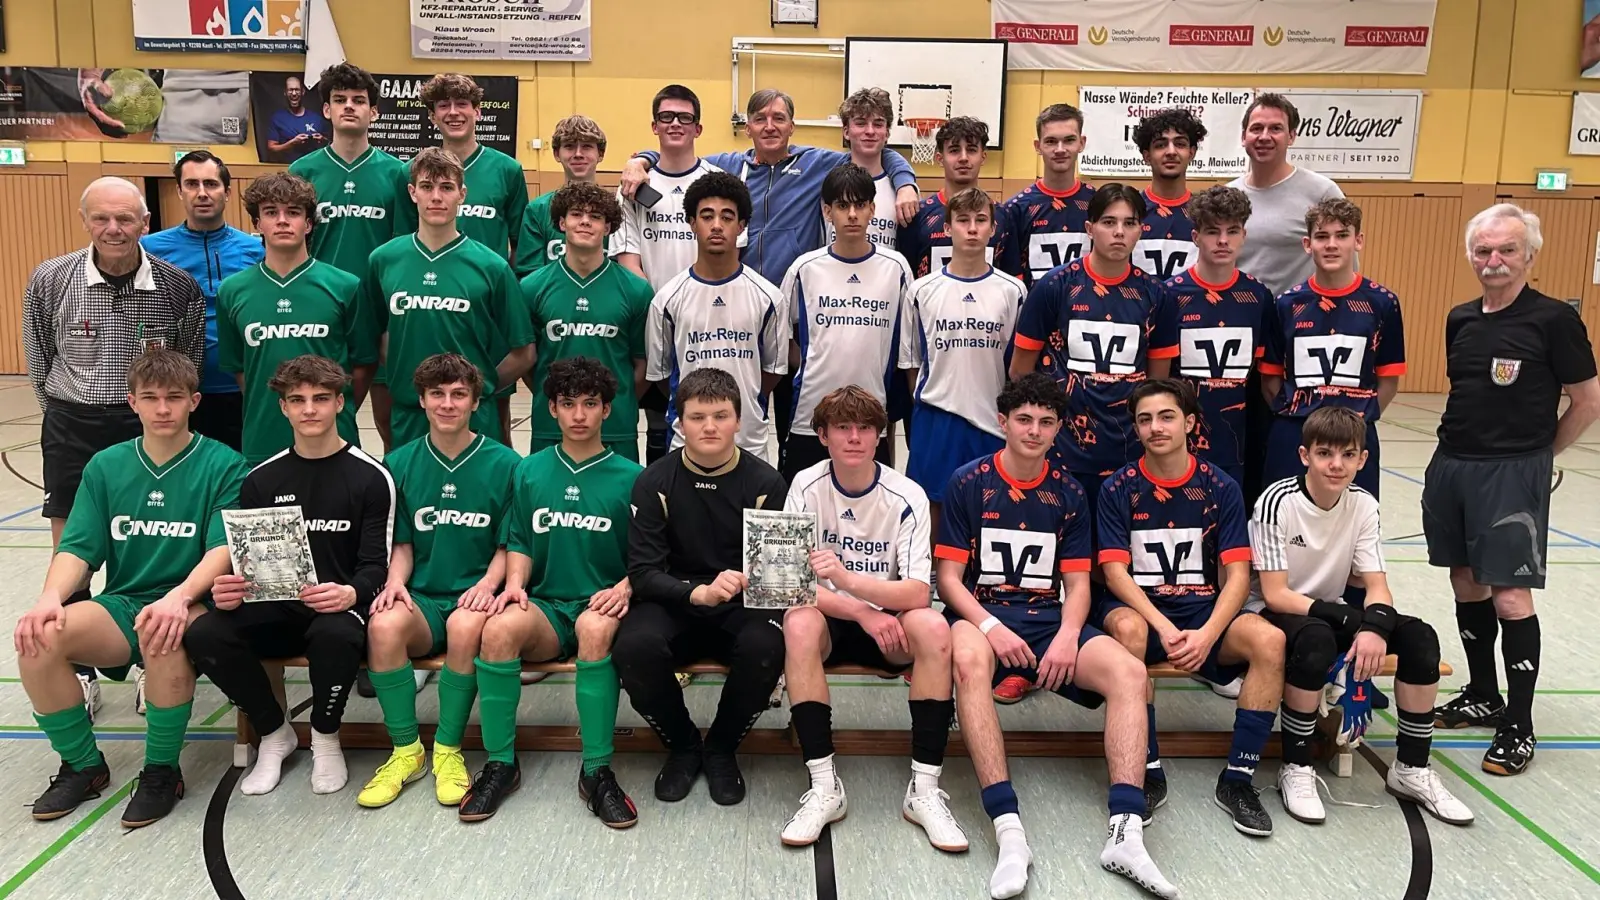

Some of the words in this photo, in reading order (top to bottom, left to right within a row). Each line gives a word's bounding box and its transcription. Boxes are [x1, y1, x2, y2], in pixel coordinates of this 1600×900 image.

[420, 4, 495, 12] KFZ-REPARATUR
[419, 12, 540, 20] UNFALL-INSTANDSETZUNG
[1016, 27, 1075, 41] GENERALI
[1191, 29, 1250, 41] GENERALI
[1287, 36, 1336, 44] Vermögensberatung
[1367, 29, 1425, 43] GENERALI
[1084, 91, 1116, 104] Nasse
[1119, 91, 1164, 104] Wände?
[1167, 90, 1208, 104] Feuchte
[1212, 91, 1249, 105] Keller?
[18, 117, 55, 125] PARTNER!
[1326, 106, 1403, 143] Wagner
[1081, 155, 1150, 169] Abdichtungstec
[1208, 156, 1245, 167] Maiwald
[1291, 154, 1339, 162] PARTNER
[1350, 154, 1372, 162] SEIT
[317, 201, 386, 223] CONRAD
[389, 291, 471, 316] CONRAD
[818, 295, 890, 312] Max-Reger
[1072, 304, 1090, 312] JAKO
[815, 313, 890, 329] Gymnasium
[1182, 314, 1201, 322] JAKO
[546, 318, 619, 342] CONRAD
[935, 317, 1005, 333] Max-Reger
[1295, 320, 1314, 329] JAKO
[244, 321, 329, 347] CONRAD
[694, 482, 717, 490] JAKO
[274, 493, 296, 504] JAKO
[414, 505, 491, 532] CONRAD
[532, 506, 612, 533] CONRAD
[981, 511, 1000, 520] JAKO
[1132, 512, 1150, 520] AKO
[110, 515, 197, 541] CONRAD
[250, 534, 286, 543] URKUNDE
[764, 538, 797, 546] URKUNDE
[1238, 751, 1260, 761] JAKO
